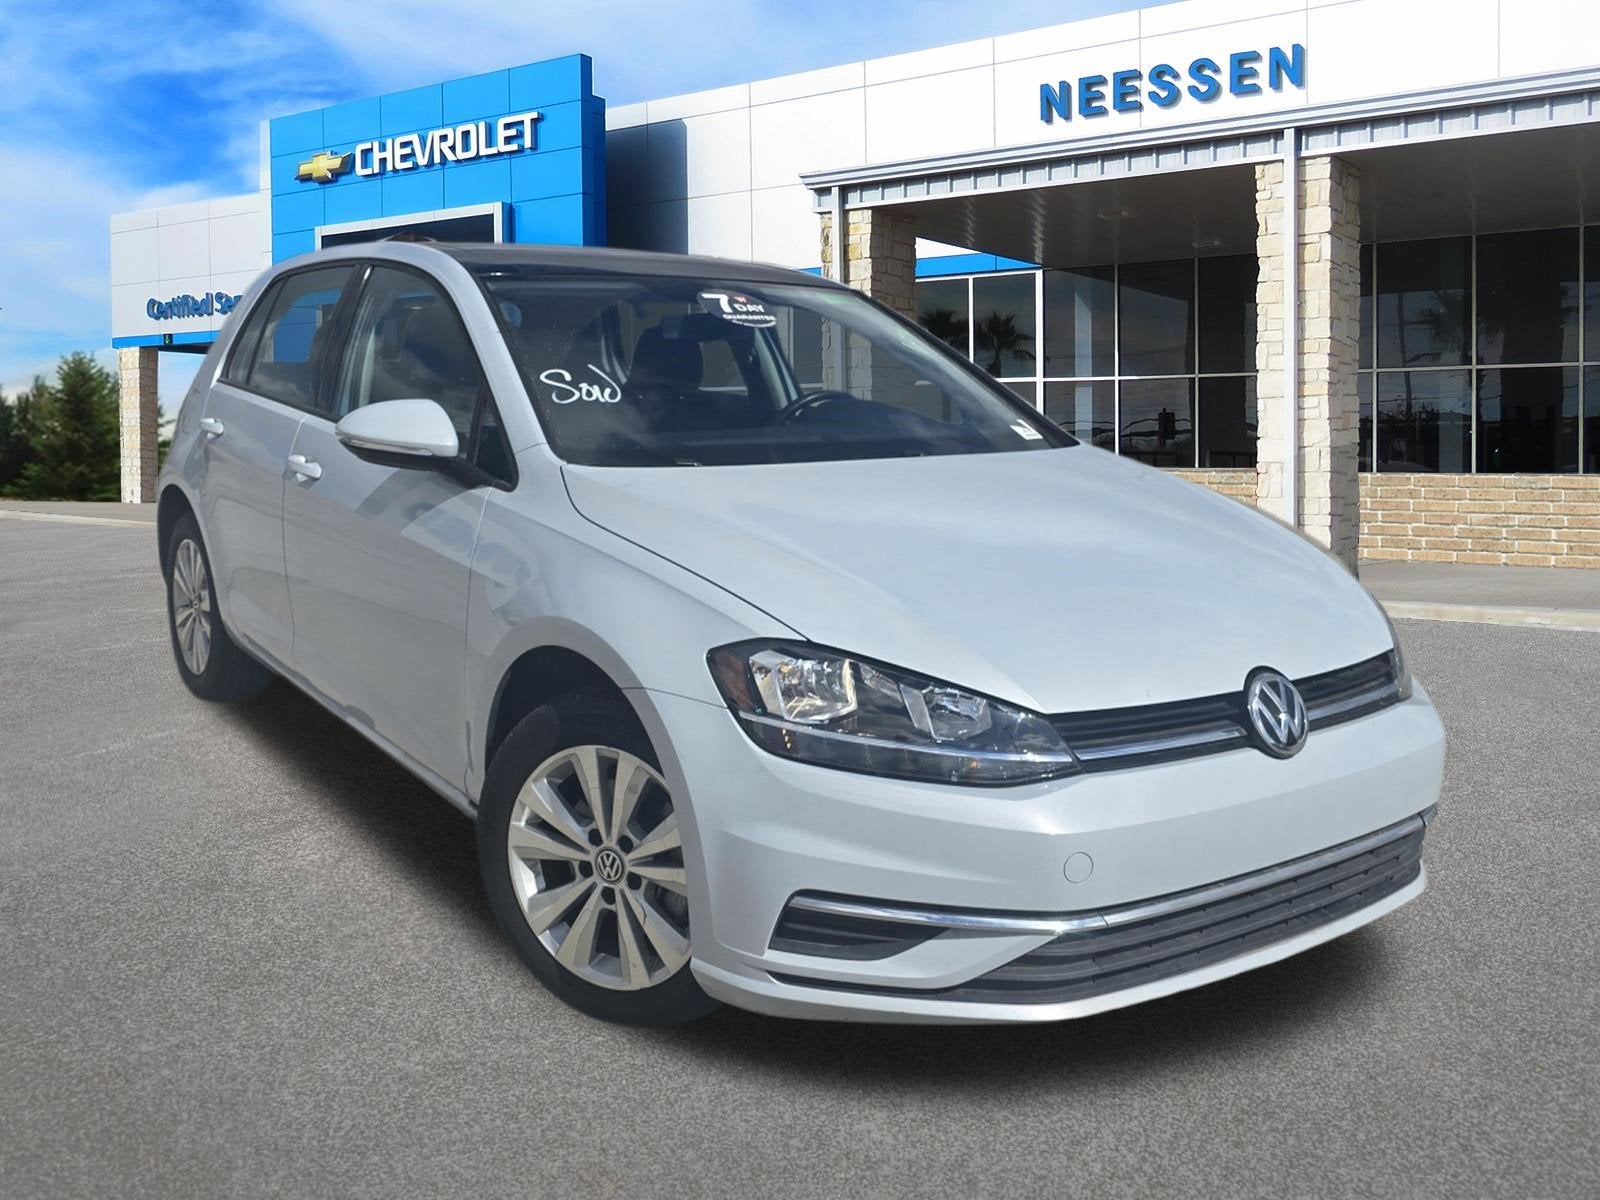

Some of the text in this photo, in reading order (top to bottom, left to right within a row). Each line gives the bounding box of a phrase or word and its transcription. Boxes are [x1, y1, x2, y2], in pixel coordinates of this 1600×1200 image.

[1039, 43, 1306, 125] NEESSEN
[354, 111, 543, 177] CHEVROLET
[146, 292, 214, 320] Certified
[700, 293, 733, 313] 7
